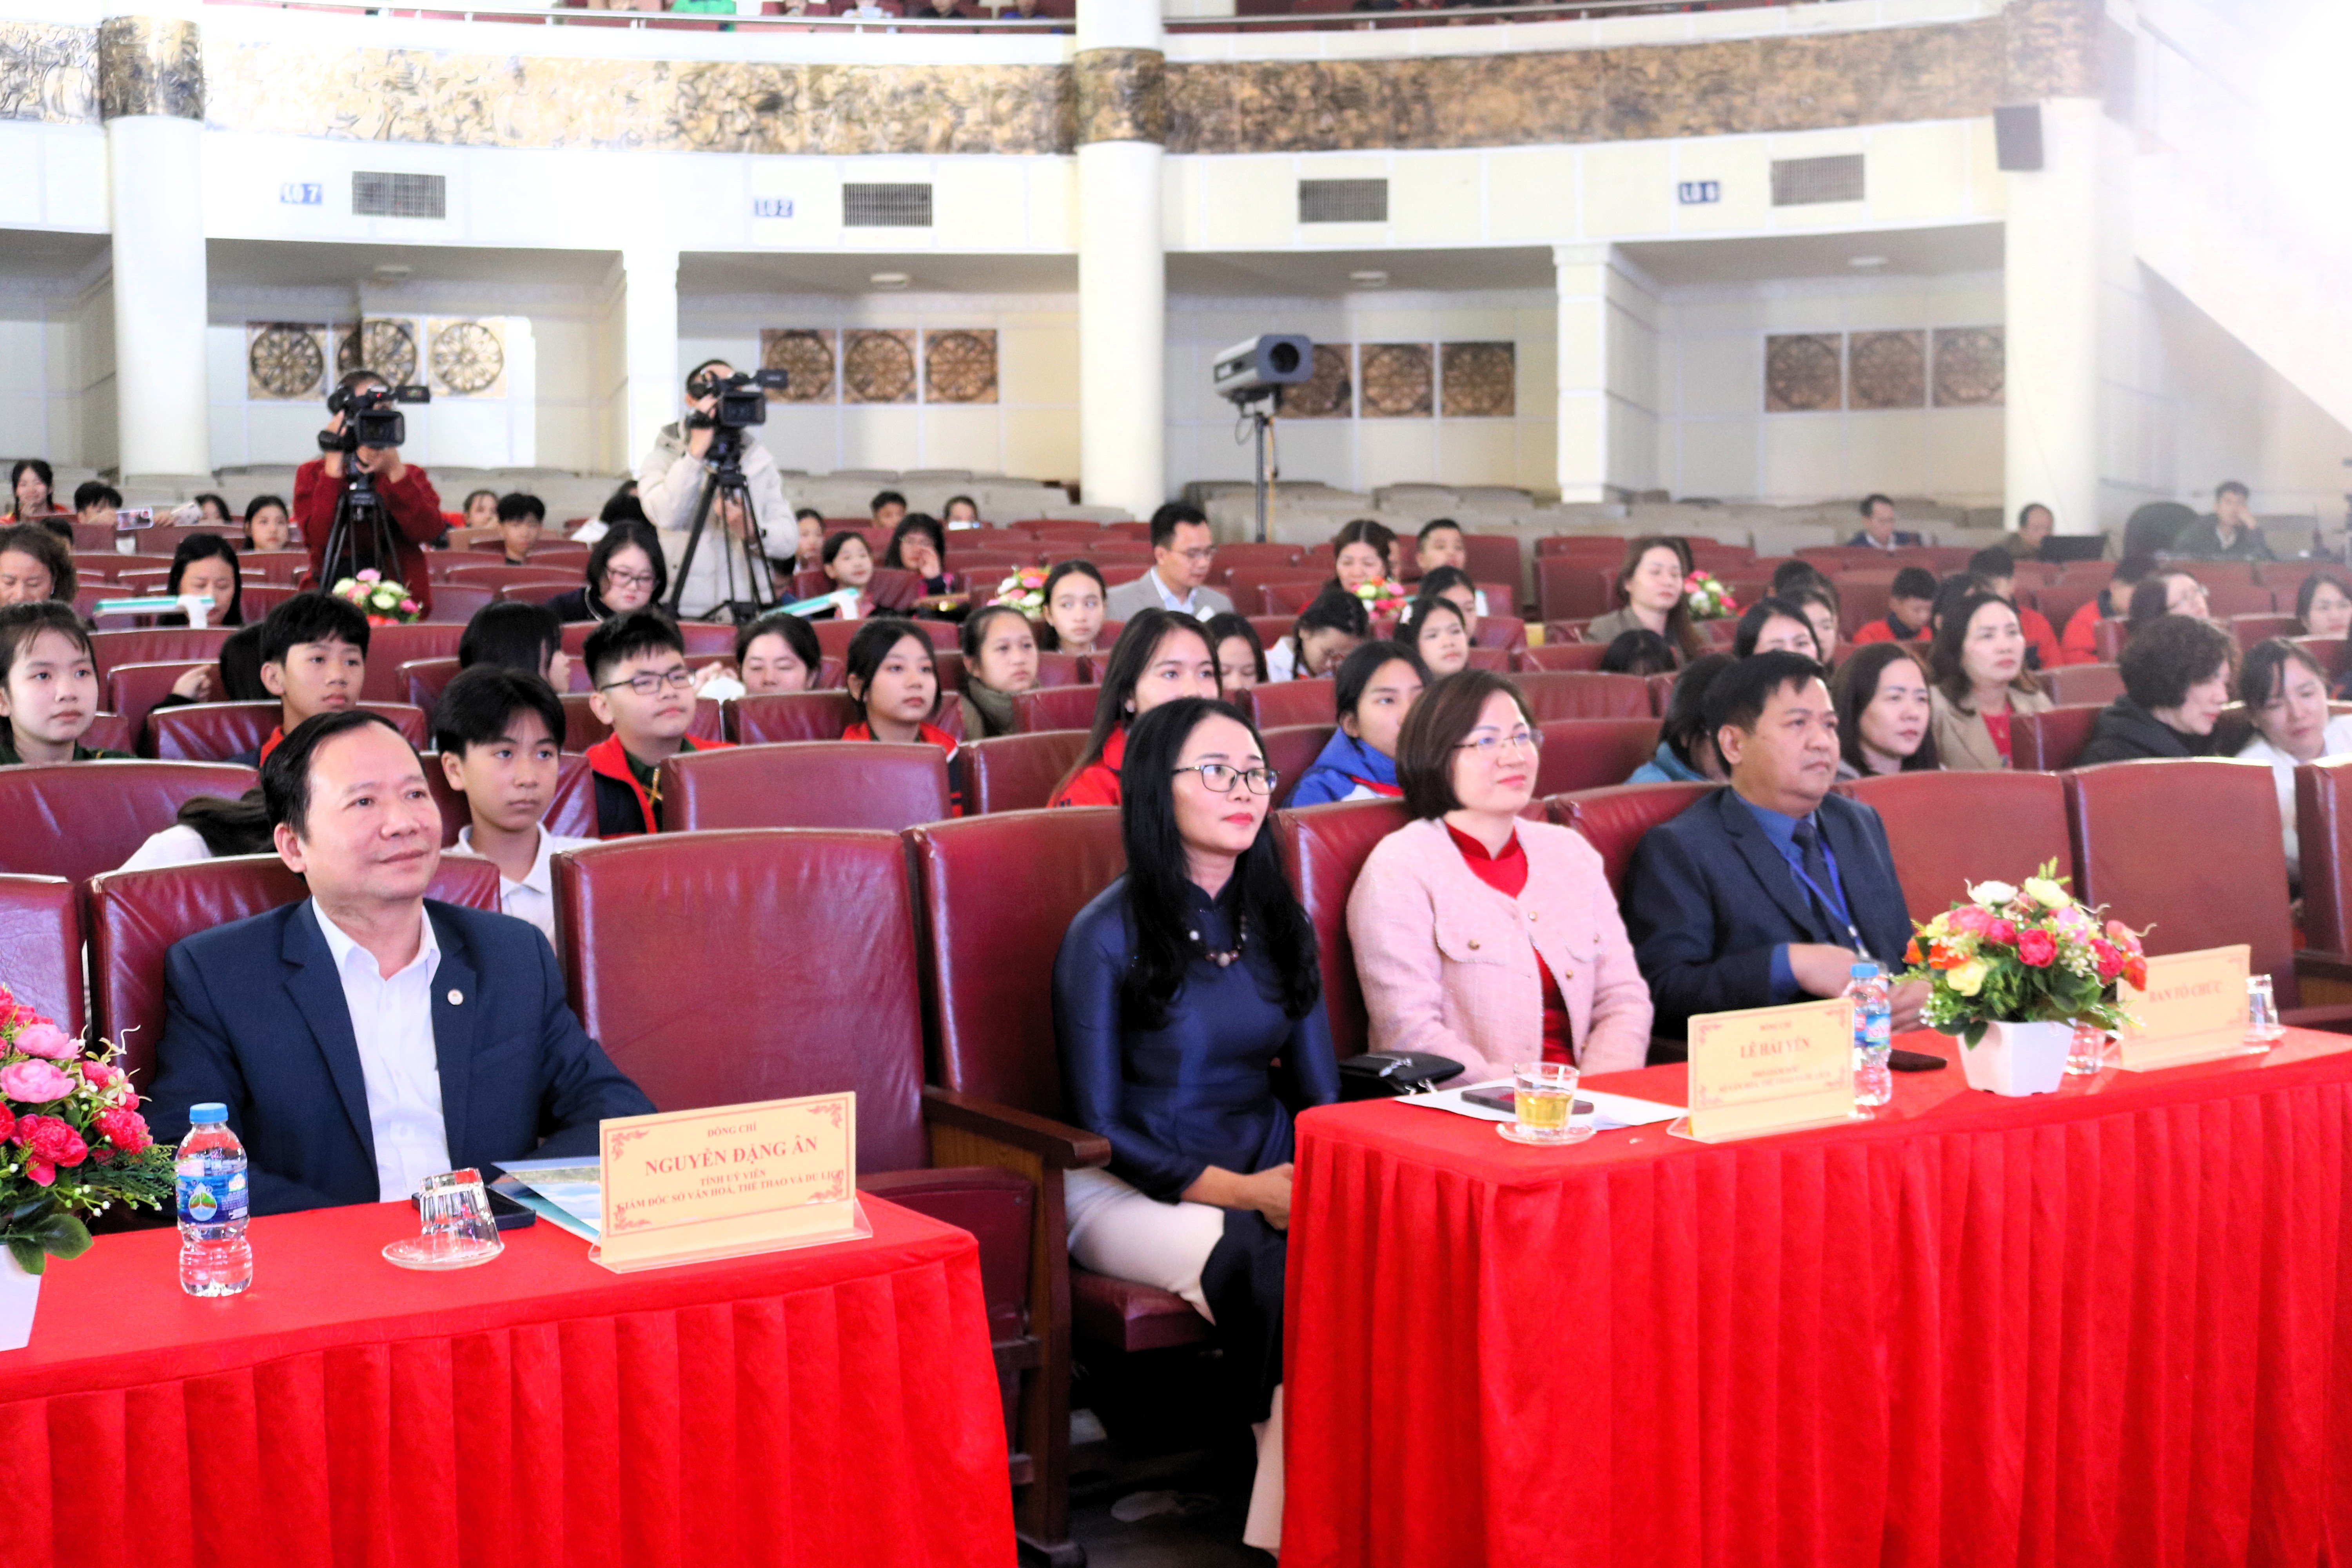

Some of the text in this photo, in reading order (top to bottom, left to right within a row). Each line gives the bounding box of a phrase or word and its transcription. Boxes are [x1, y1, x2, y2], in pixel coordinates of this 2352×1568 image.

[307, 186, 318, 202] 7
[1740, 1041, 1757, 1058] LÊ
[739, 1121, 757, 1133] CHÍ
[645, 1134, 817, 1176] NGUYỄN ĐẶNG ÂN
[743, 1168, 766, 1180] VIÊN
[688, 1189, 708, 1200] VĂN
[761, 1178, 788, 1189] THAO
[790, 1175, 803, 1183] VÀ
[806, 1173, 818, 1182] DU
